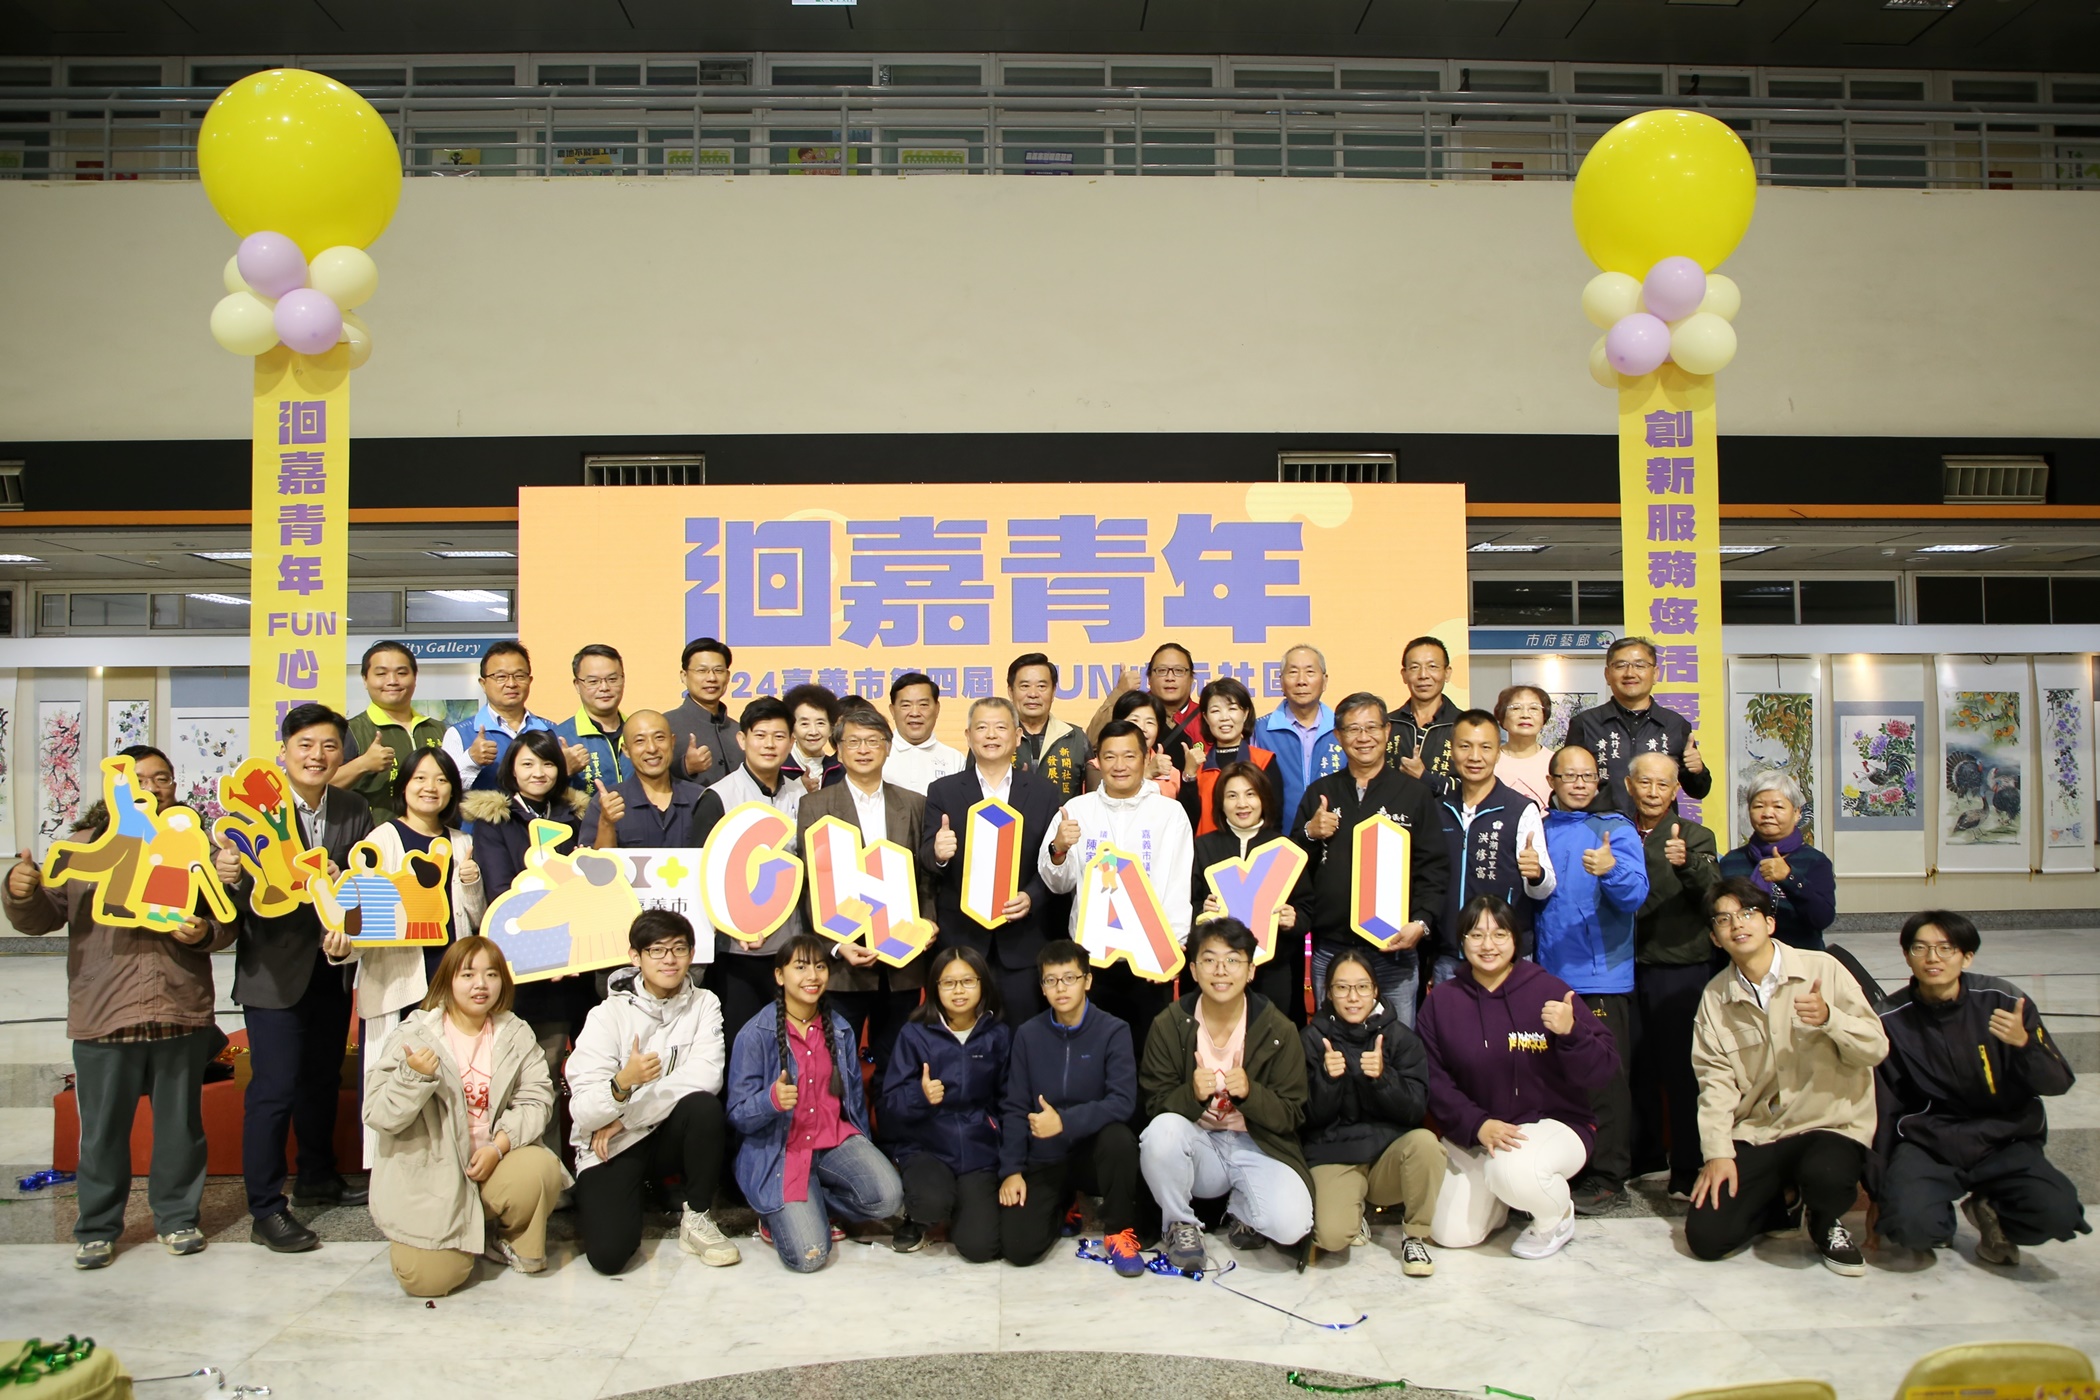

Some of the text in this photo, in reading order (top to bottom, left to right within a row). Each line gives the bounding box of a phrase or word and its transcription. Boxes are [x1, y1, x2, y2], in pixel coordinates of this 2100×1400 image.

[684, 515, 1311, 649] 洄嘉青年
[401, 641, 481, 657] ity Gallery
[1525, 633, 1592, 648] 市府藝廊
[1046, 754, 1059, 784] 發展
[1141, 829, 1152, 878] 嘉義市議
